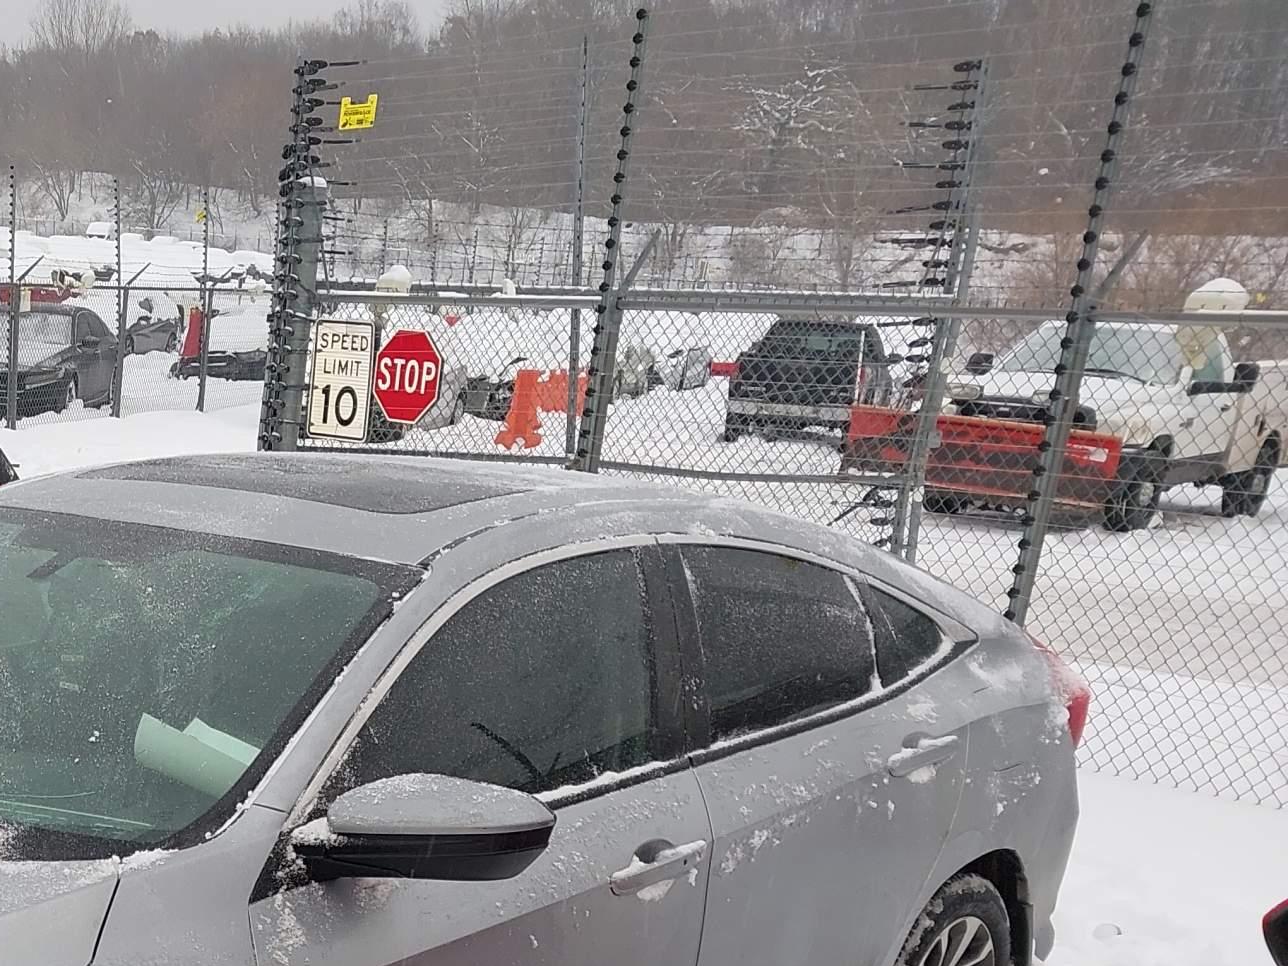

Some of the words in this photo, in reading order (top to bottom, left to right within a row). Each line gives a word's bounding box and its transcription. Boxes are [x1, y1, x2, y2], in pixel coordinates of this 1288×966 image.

[320, 333, 369, 351] SPEED
[323, 358, 362, 377] LIMIT
[377, 356, 436, 395] STOP
[321, 384, 358, 426] 10
